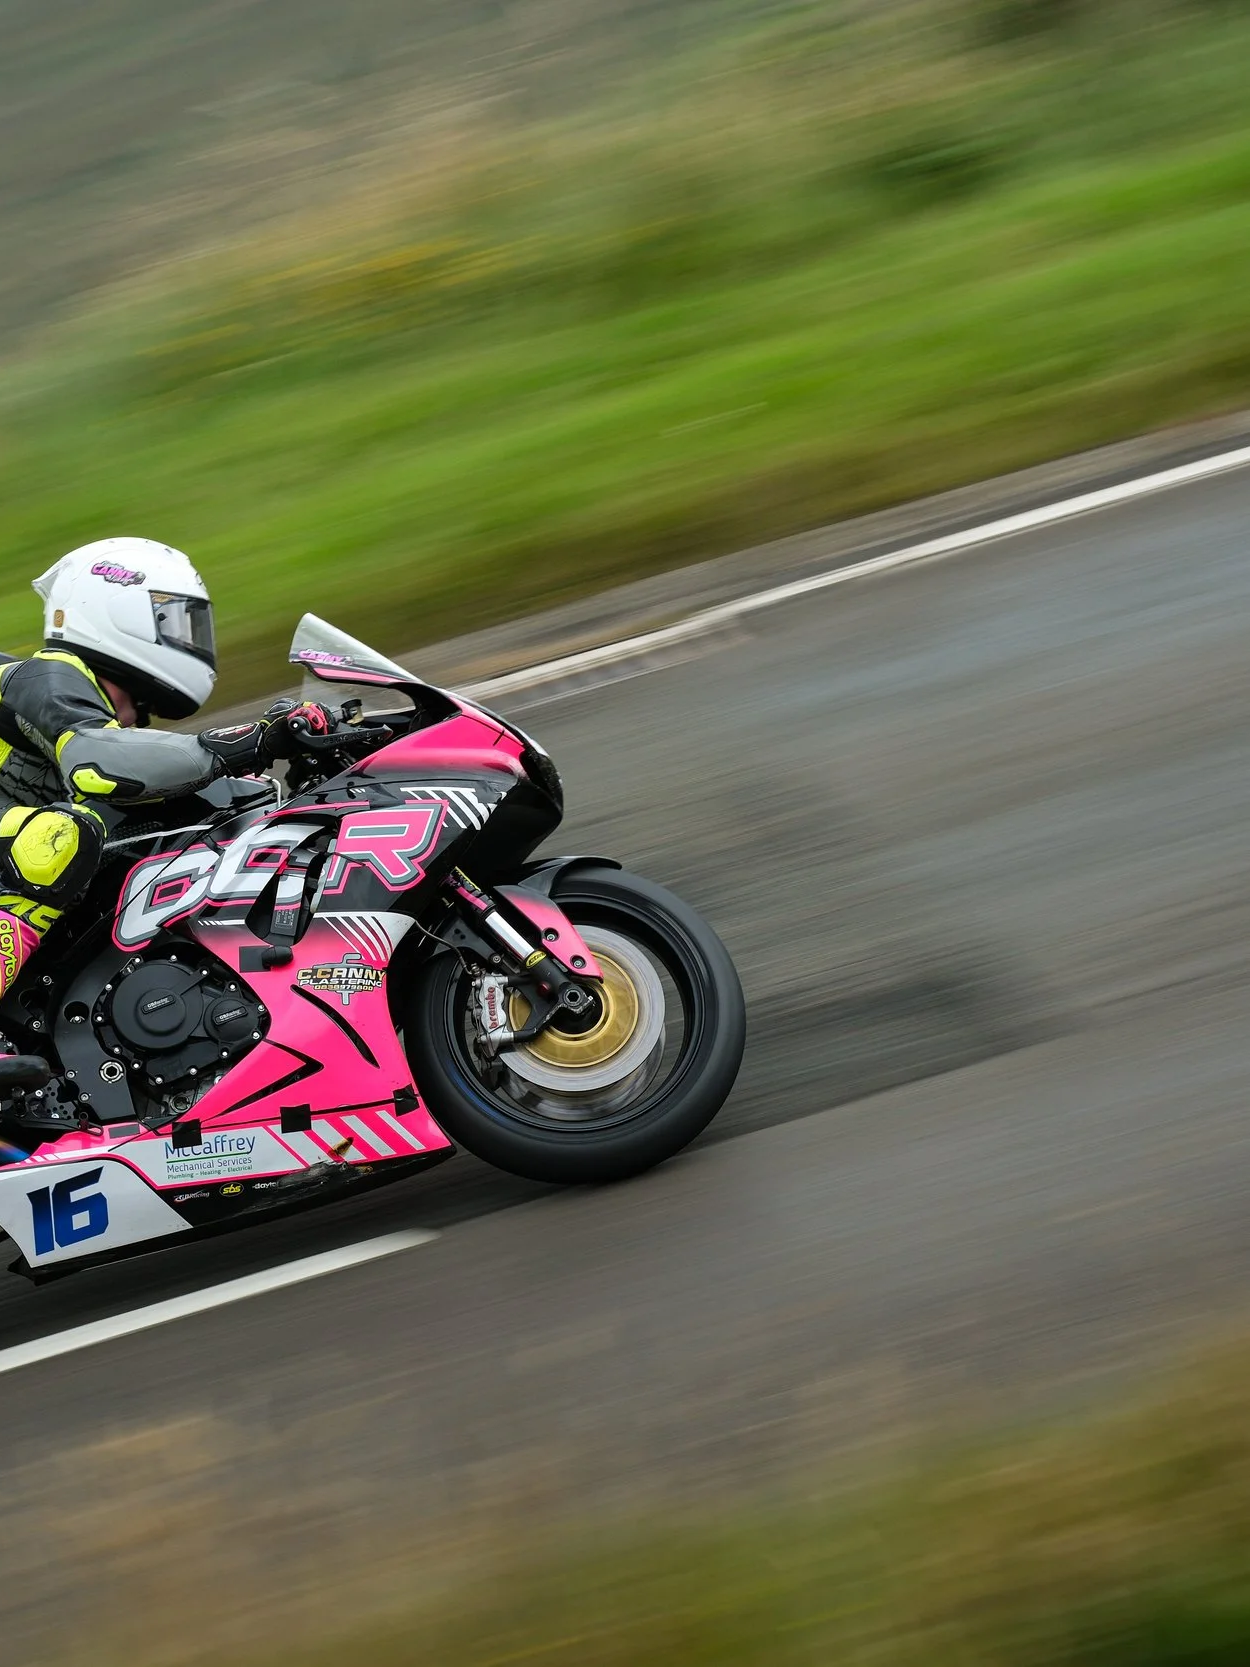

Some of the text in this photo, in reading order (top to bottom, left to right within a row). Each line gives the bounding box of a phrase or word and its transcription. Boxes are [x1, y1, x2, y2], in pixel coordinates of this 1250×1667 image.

[297, 967, 386, 981] C.CANNY
[299, 978, 382, 987] PLASTERING
[485, 986, 499, 1029] brembo
[166, 1156, 252, 1173] Mechanical Services
[167, 1172, 194, 1180] Plumbing
[200, 1168, 222, 1176] Heating
[227, 1164, 253, 1173] Electrical
[26, 1165, 109, 1256] 16
